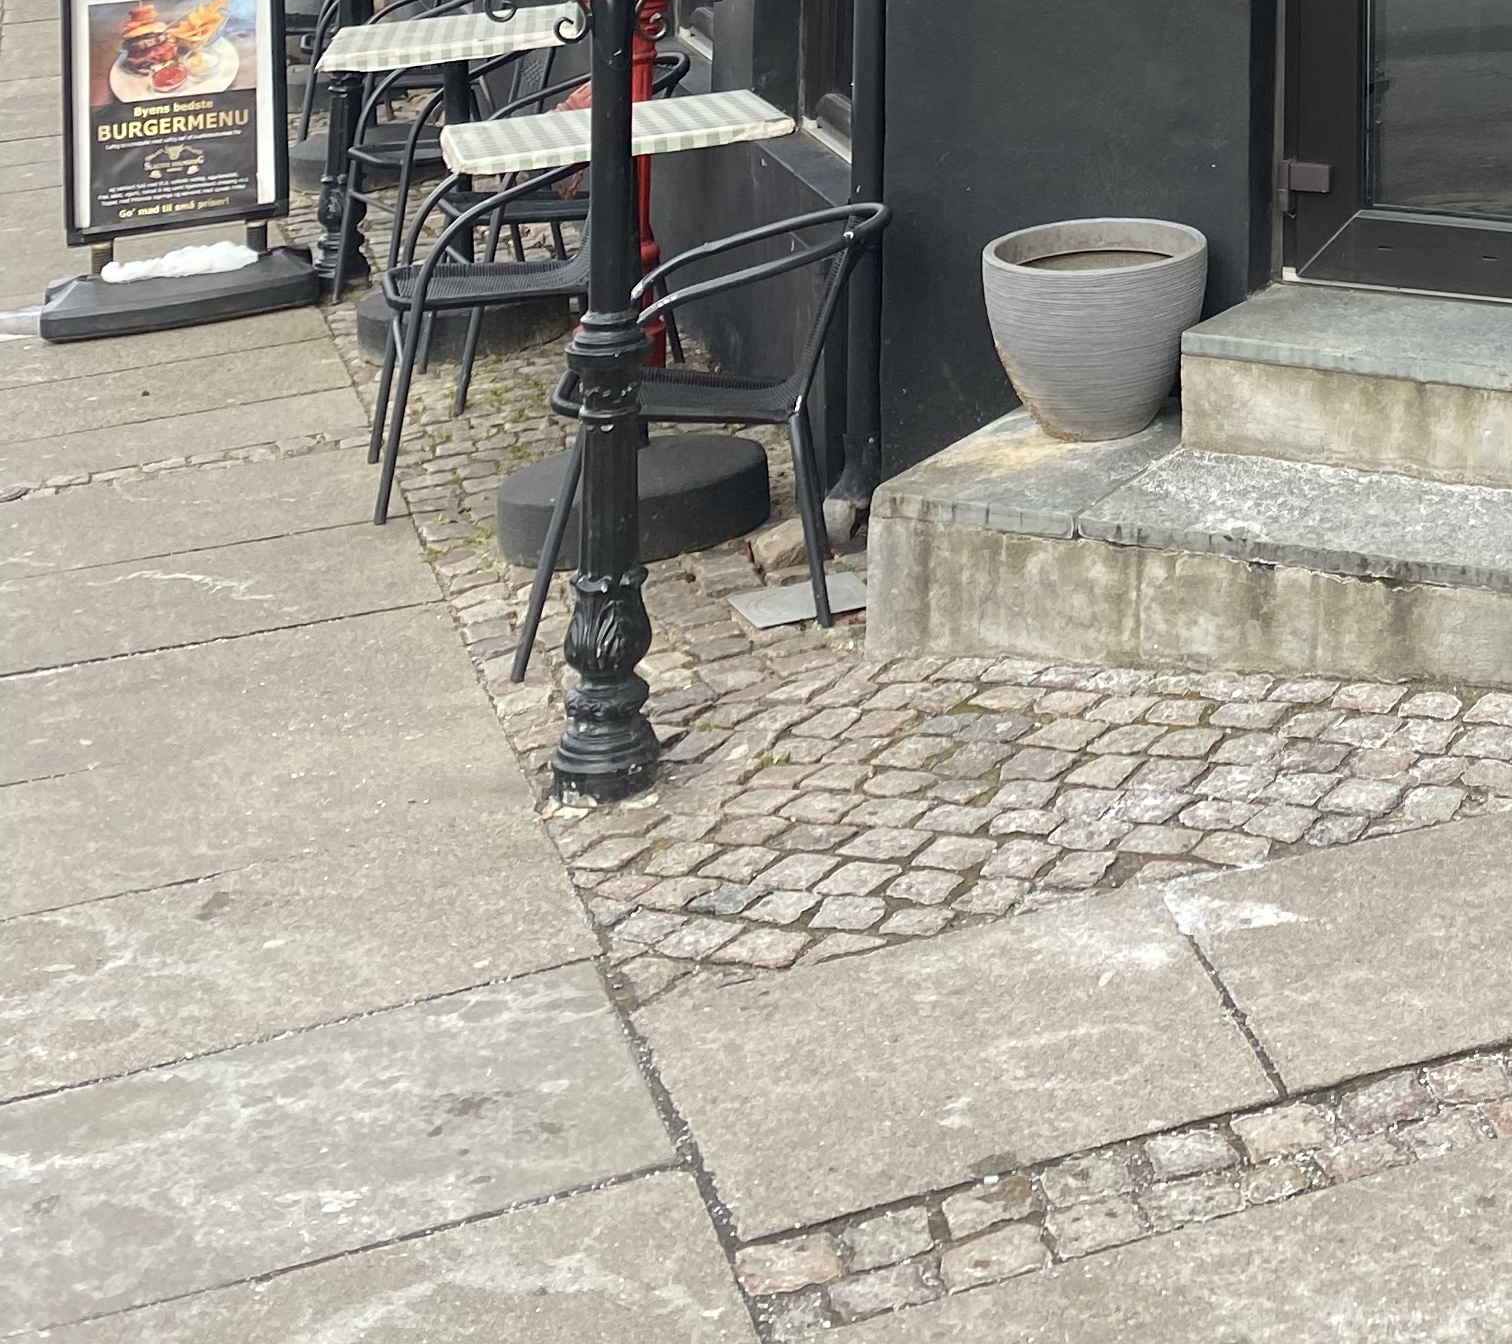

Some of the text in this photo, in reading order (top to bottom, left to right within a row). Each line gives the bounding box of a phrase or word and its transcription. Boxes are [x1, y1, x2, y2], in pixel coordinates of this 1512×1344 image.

[133, 100, 214, 117] Byens bedste
[97, 109, 249, 142] BURGERMENU
[138, 205, 160, 216] mad
[162, 203, 173, 213] til
[174, 200, 195, 212] små
